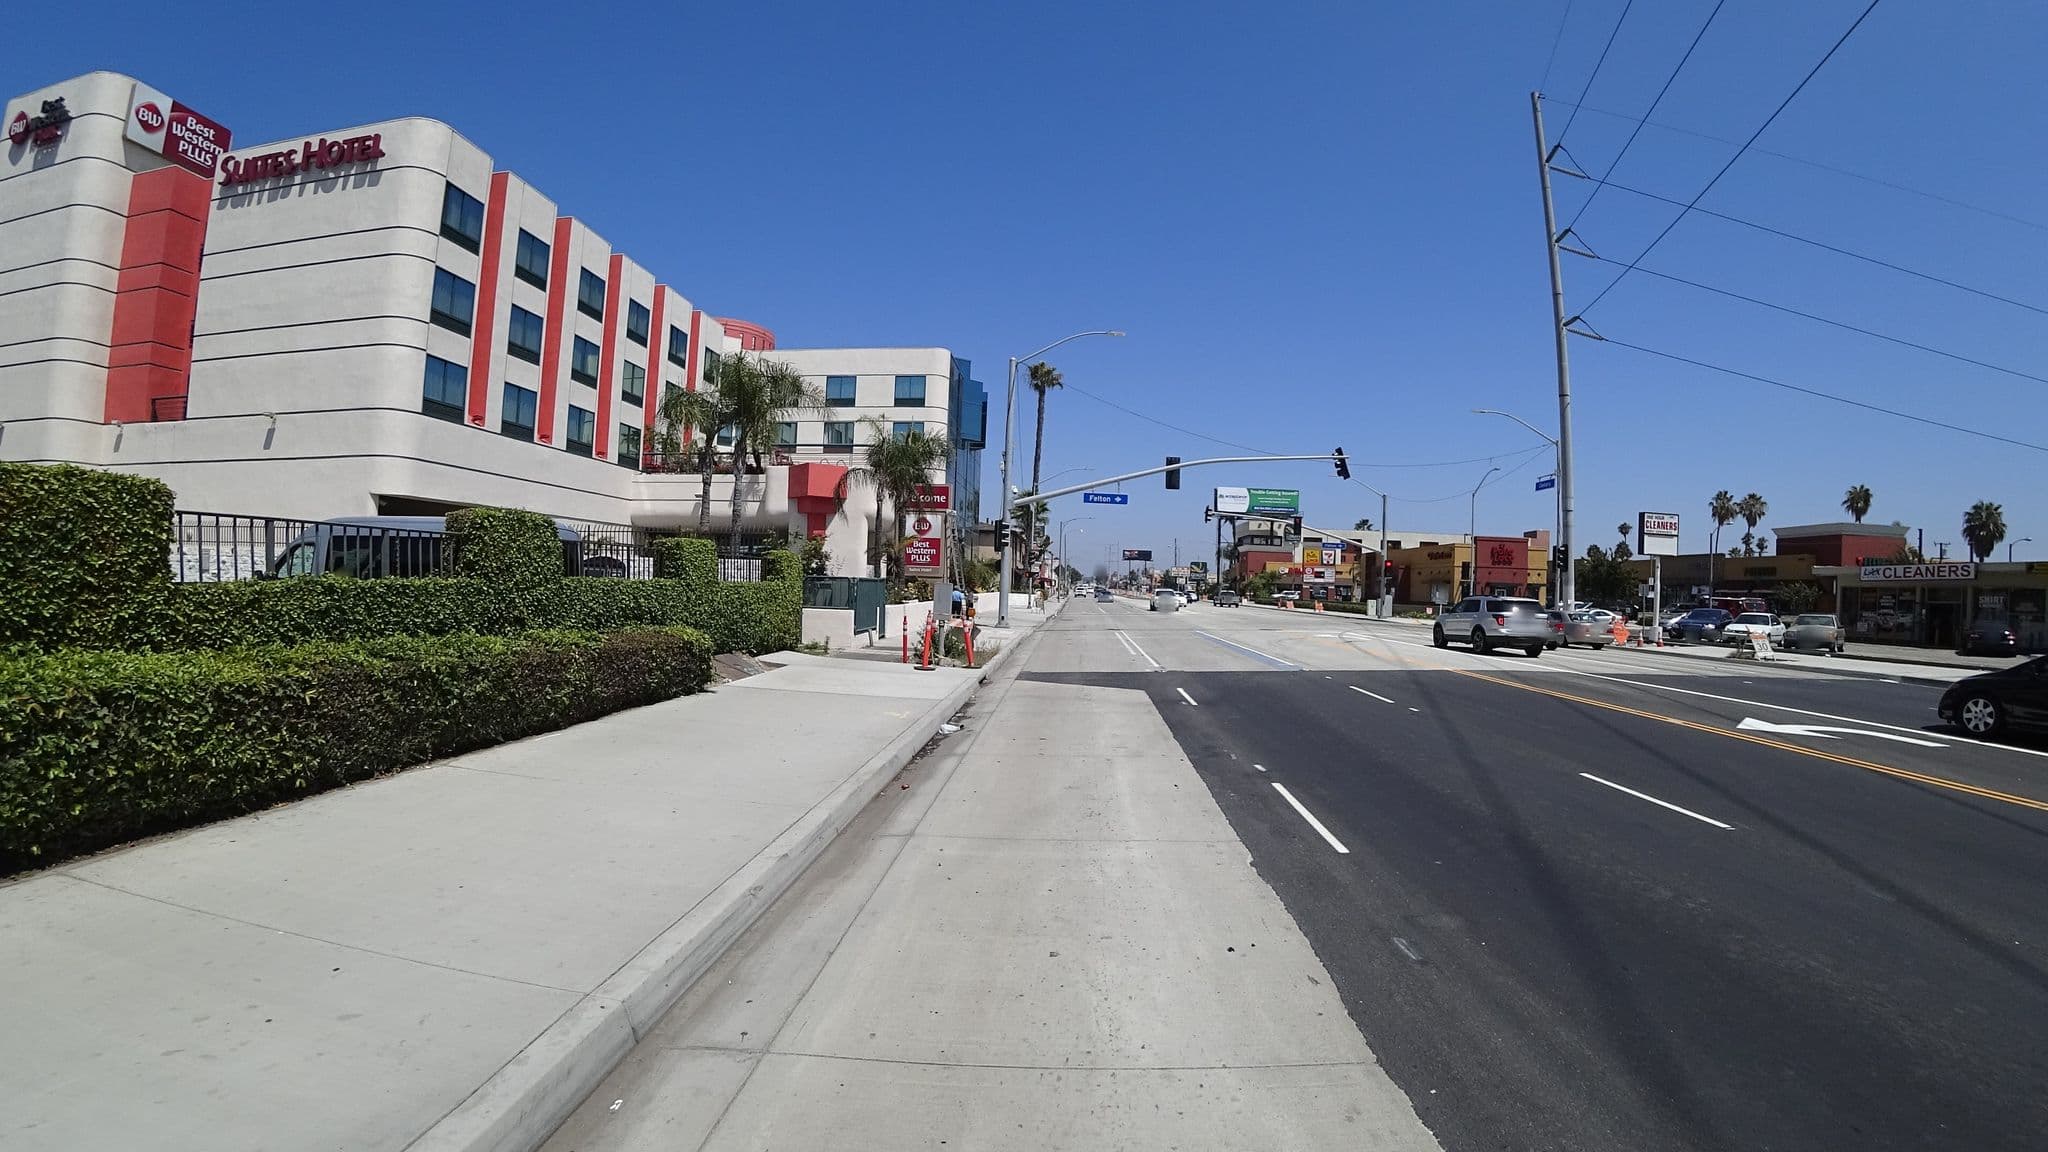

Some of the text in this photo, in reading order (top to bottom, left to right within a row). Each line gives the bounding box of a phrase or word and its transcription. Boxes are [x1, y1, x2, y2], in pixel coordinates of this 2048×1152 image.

[138, 107, 161, 127] BW
[187, 116, 216, 140] Best
[172, 121, 224, 156] Western
[178, 140, 213, 166] PLUS
[1089, 494, 1111, 503] Felton
[1645, 519, 1678, 532] CLEANERS
[906, 546, 936, 555] Western
[913, 540, 930, 548] Best
[911, 554, 932, 562] PLUS
[1882, 564, 1972, 579] CLEANERS
[1755, 642, 1769, 651] 30
